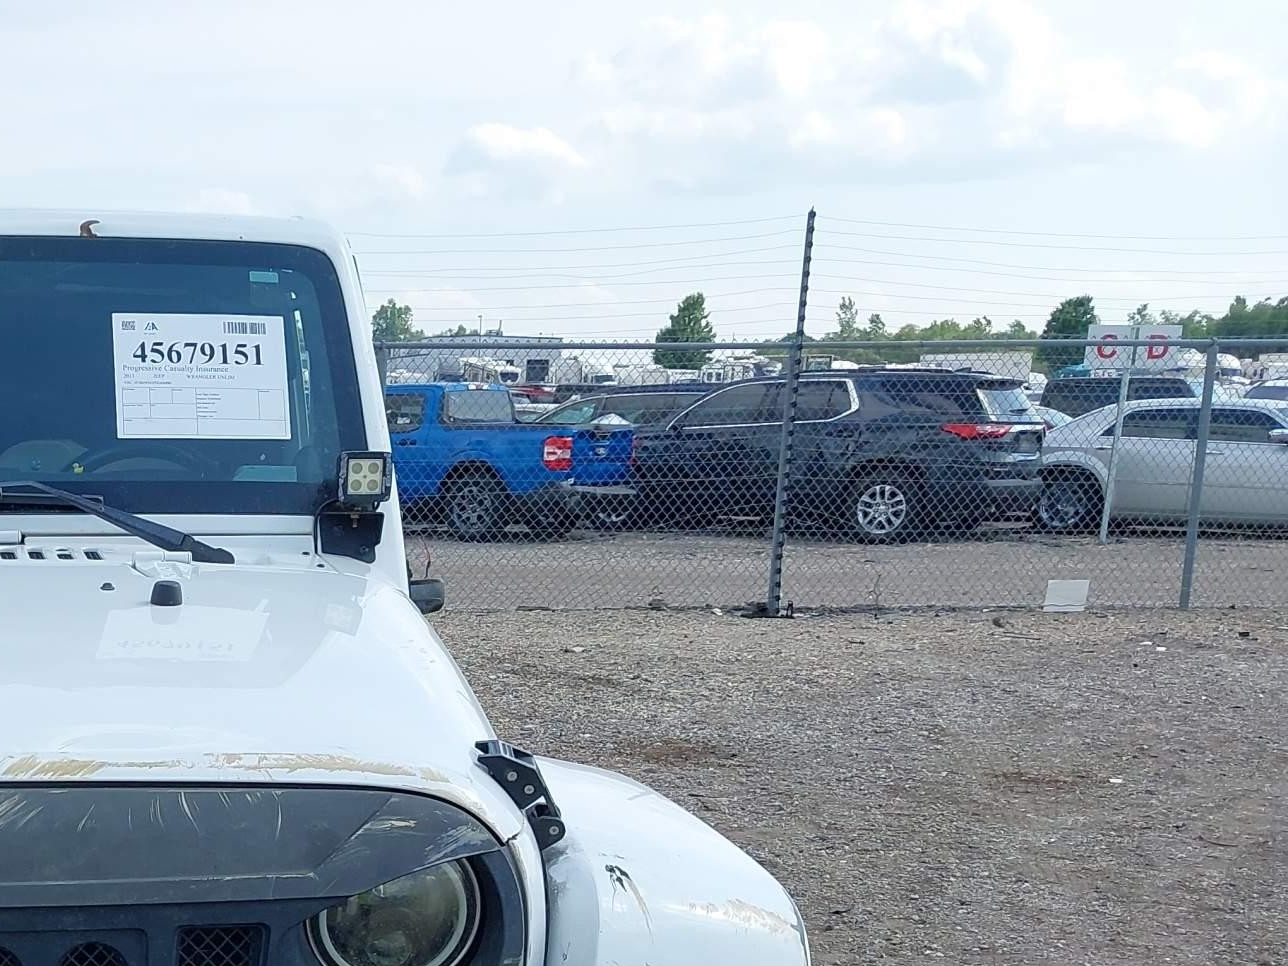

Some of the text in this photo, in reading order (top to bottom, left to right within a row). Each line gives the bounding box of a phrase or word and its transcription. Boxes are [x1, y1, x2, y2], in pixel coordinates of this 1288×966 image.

[133, 341, 264, 366] 45679151
[1097, 334, 1118, 359] C
[1147, 334, 1169, 360] D
[122, 364, 162, 373] Progressive
[164, 365, 194, 373] Casualty
